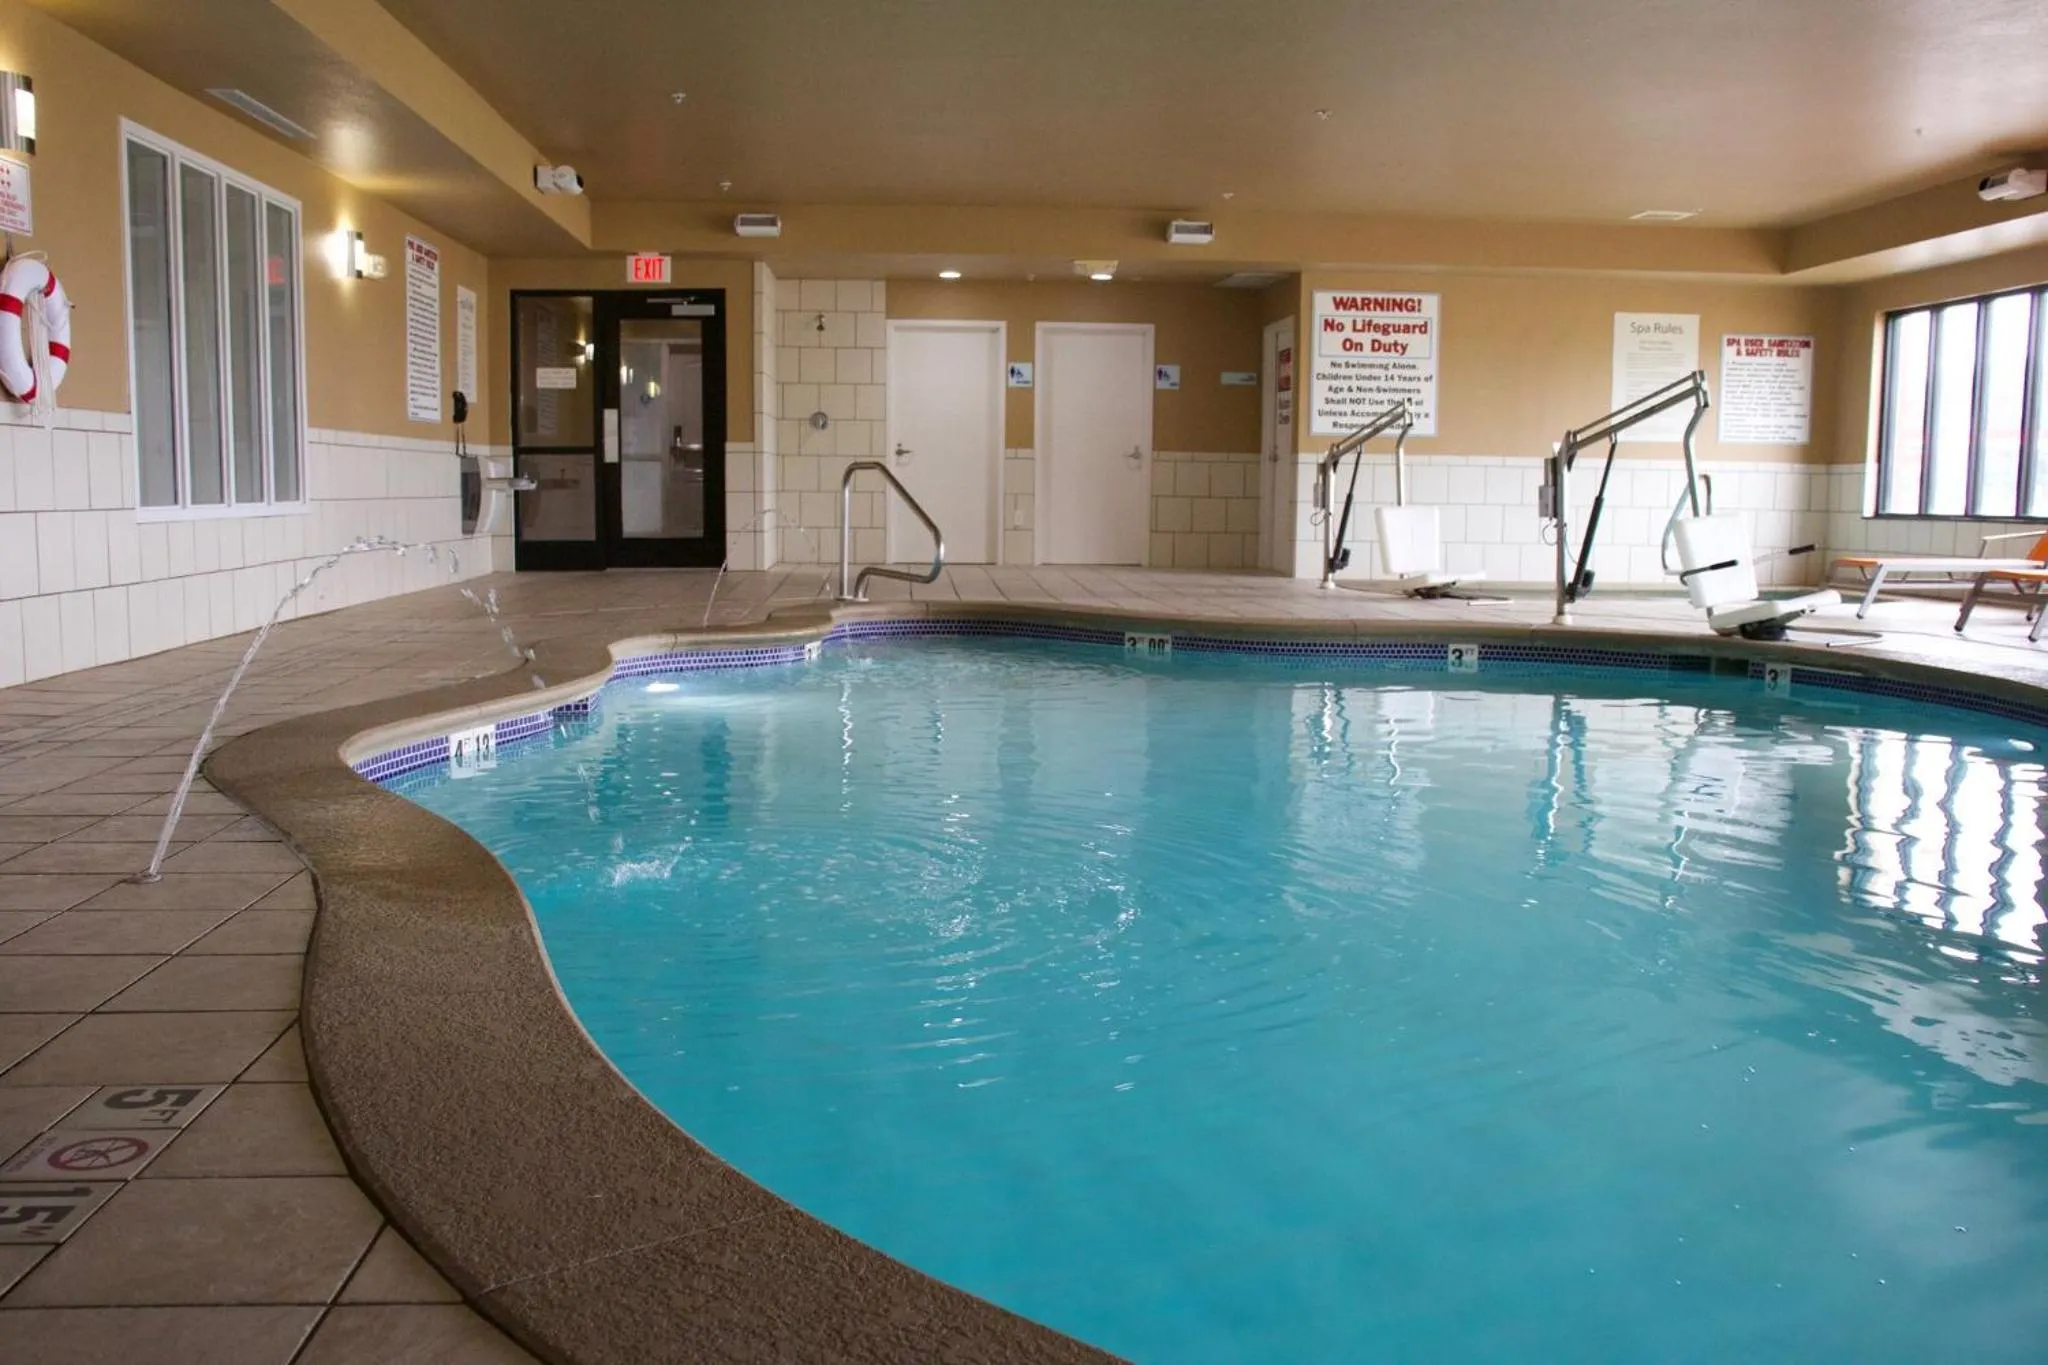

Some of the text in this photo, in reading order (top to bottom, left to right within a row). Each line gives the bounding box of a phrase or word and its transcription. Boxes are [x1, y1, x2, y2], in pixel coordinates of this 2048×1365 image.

[634, 257, 664, 280] EXIT
[1332, 296, 1422, 313] WARNING!
[1323, 318, 1428, 336] No Lifeguard
[1630, 322, 1684, 335] Spa Rules
[1342, 338, 1408, 356] On Duty
[1330, 361, 1342, 369] No
[1345, 361, 1389, 371] Swimming
[1316, 373, 1353, 381] Children
[1355, 373, 1382, 381] Under
[1397, 374, 1421, 382] Years
[1328, 386, 1345, 394] Age
[1324, 397, 1347, 405] Shall
[1369, 398, 1384, 406] Use
[1318, 409, 1348, 417] Unless
[104, 1088, 203, 1110] 5
